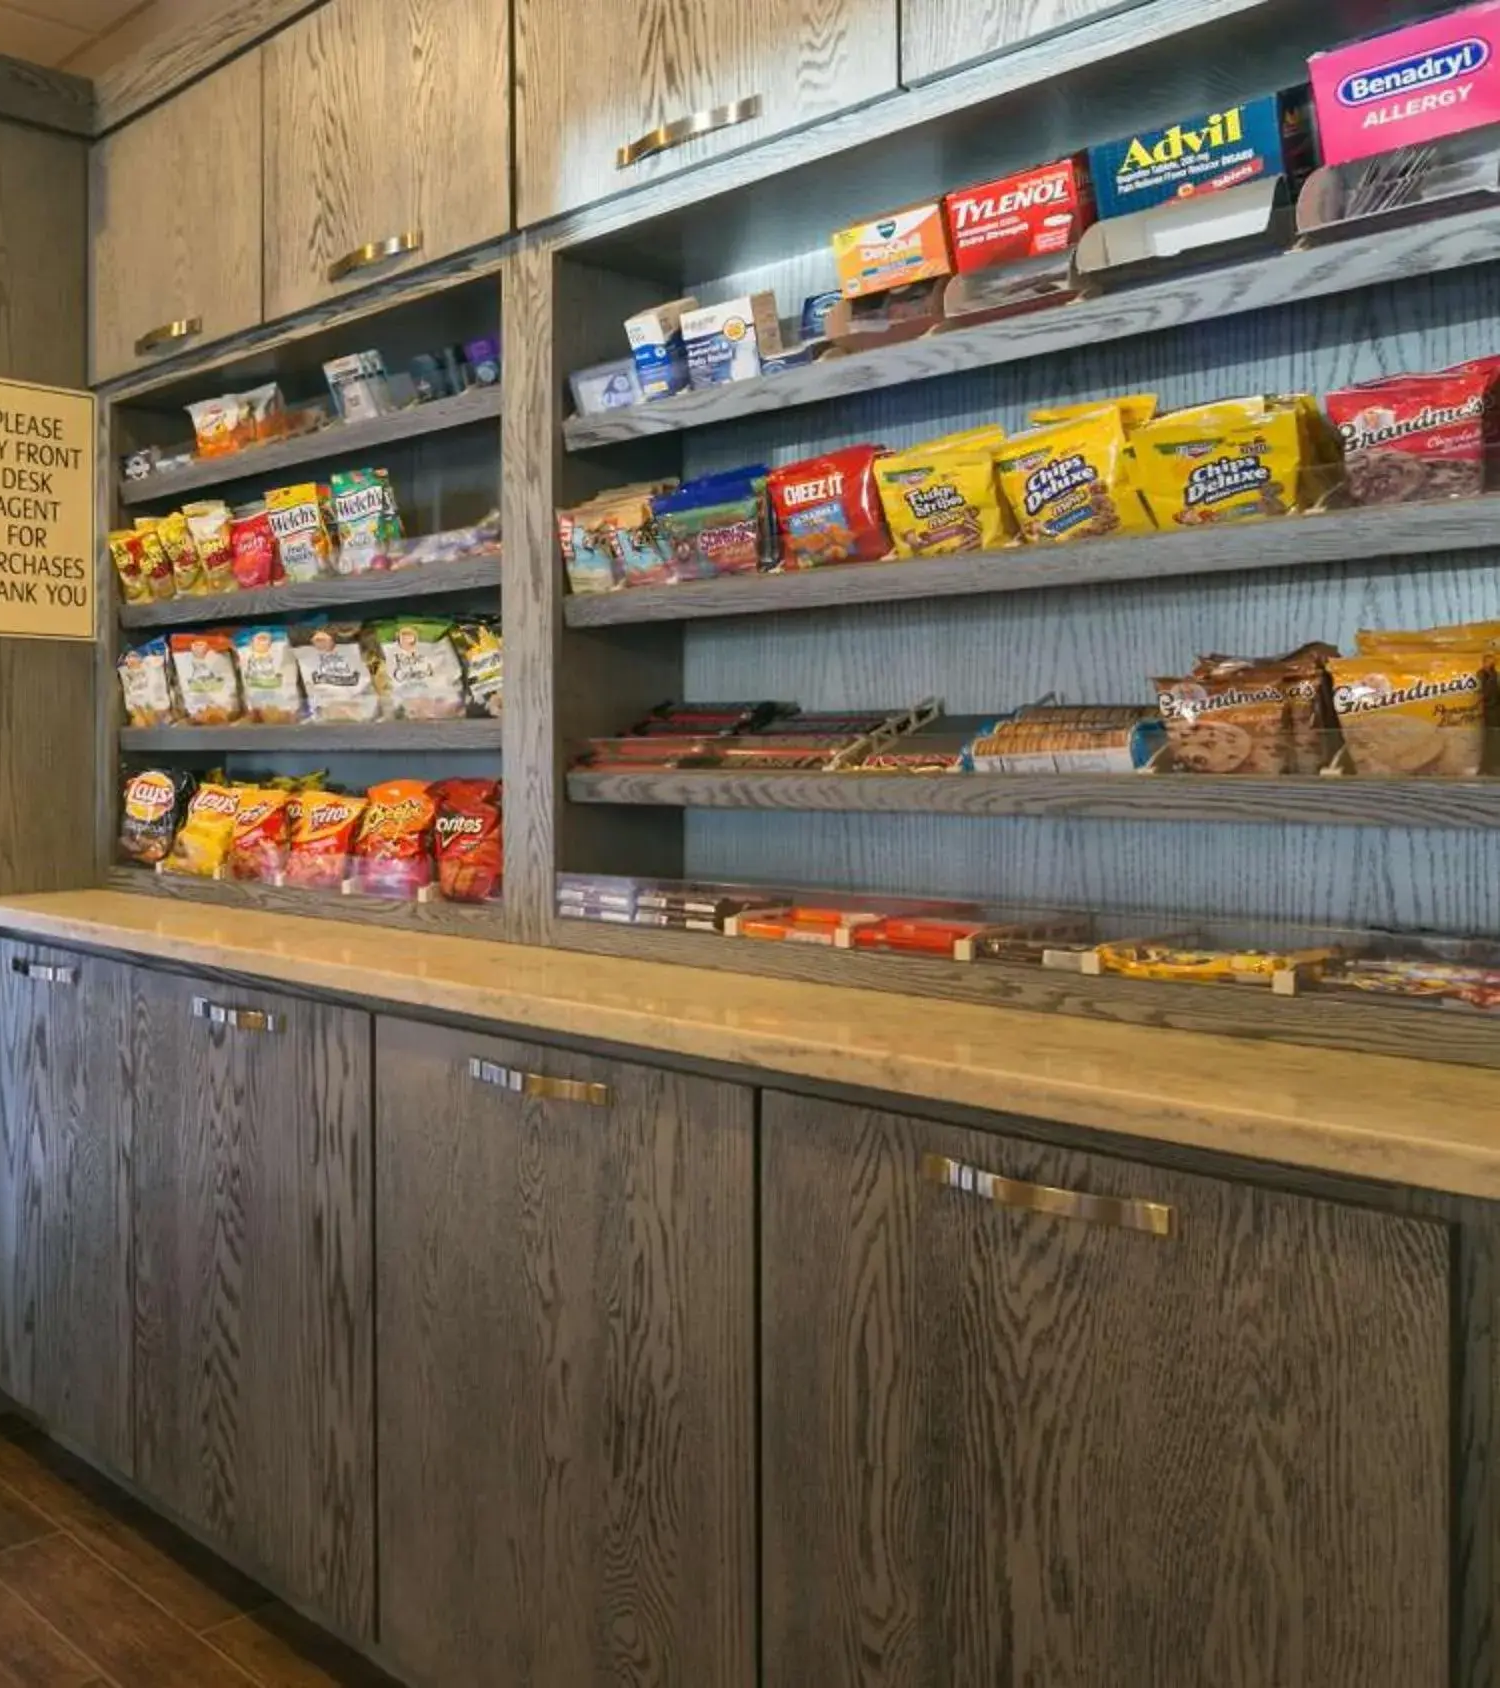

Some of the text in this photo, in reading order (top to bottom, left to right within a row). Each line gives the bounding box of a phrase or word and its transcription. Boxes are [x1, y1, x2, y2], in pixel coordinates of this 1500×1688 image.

[1351, 46, 1474, 99] Benadryl
[1362, 82, 1474, 128] ALLERGY
[1117, 106, 1243, 174] Advil
[952, 179, 1068, 230] TYLENOL
[15, 441, 83, 470] FRONT
[1193, 456, 1255, 482] Chips
[2, 467, 53, 494] DESK
[1027, 466, 1095, 514] Deluxe
[1028, 455, 1082, 491] Chips
[1187, 467, 1268, 503] Deluxe
[271, 505, 317, 533] Welch's
[338, 487, 382, 519] Welch's
[7, 524, 47, 549] FOR
[46, 585, 87, 608] YOU
